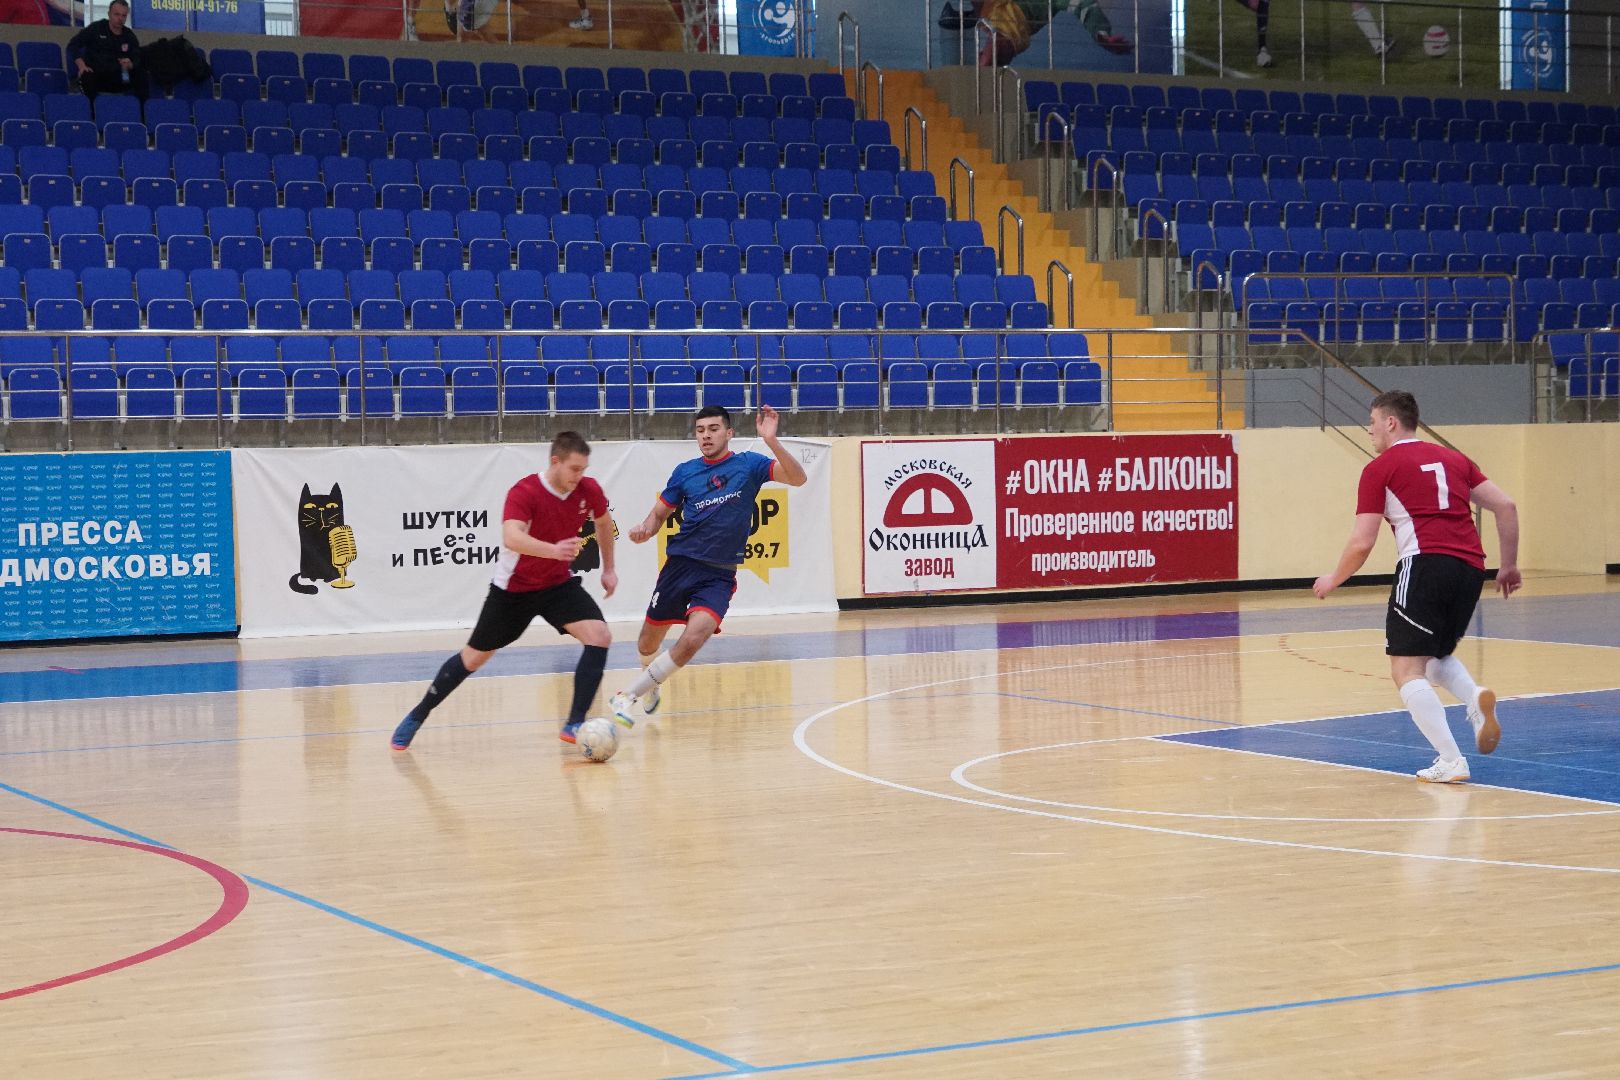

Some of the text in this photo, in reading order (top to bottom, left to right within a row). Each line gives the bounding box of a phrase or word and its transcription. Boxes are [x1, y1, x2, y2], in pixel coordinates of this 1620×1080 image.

[801, 448, 818, 464] 12+
[1006, 456, 1232, 495] #ОКНА #БАЛКОНЫ
[1421, 462, 1449, 510] 7
[18, 520, 144, 546] ПРЕССА
[402, 510, 488, 530] ШУТКИ
[1005, 502, 1233, 542] Проверенное качество!
[391, 553, 404, 567] и
[744, 542, 780, 559] 89.7
[1031, 549, 1156, 576] производитель
[0, 552, 211, 587] ДМОСКОВЬЯ
